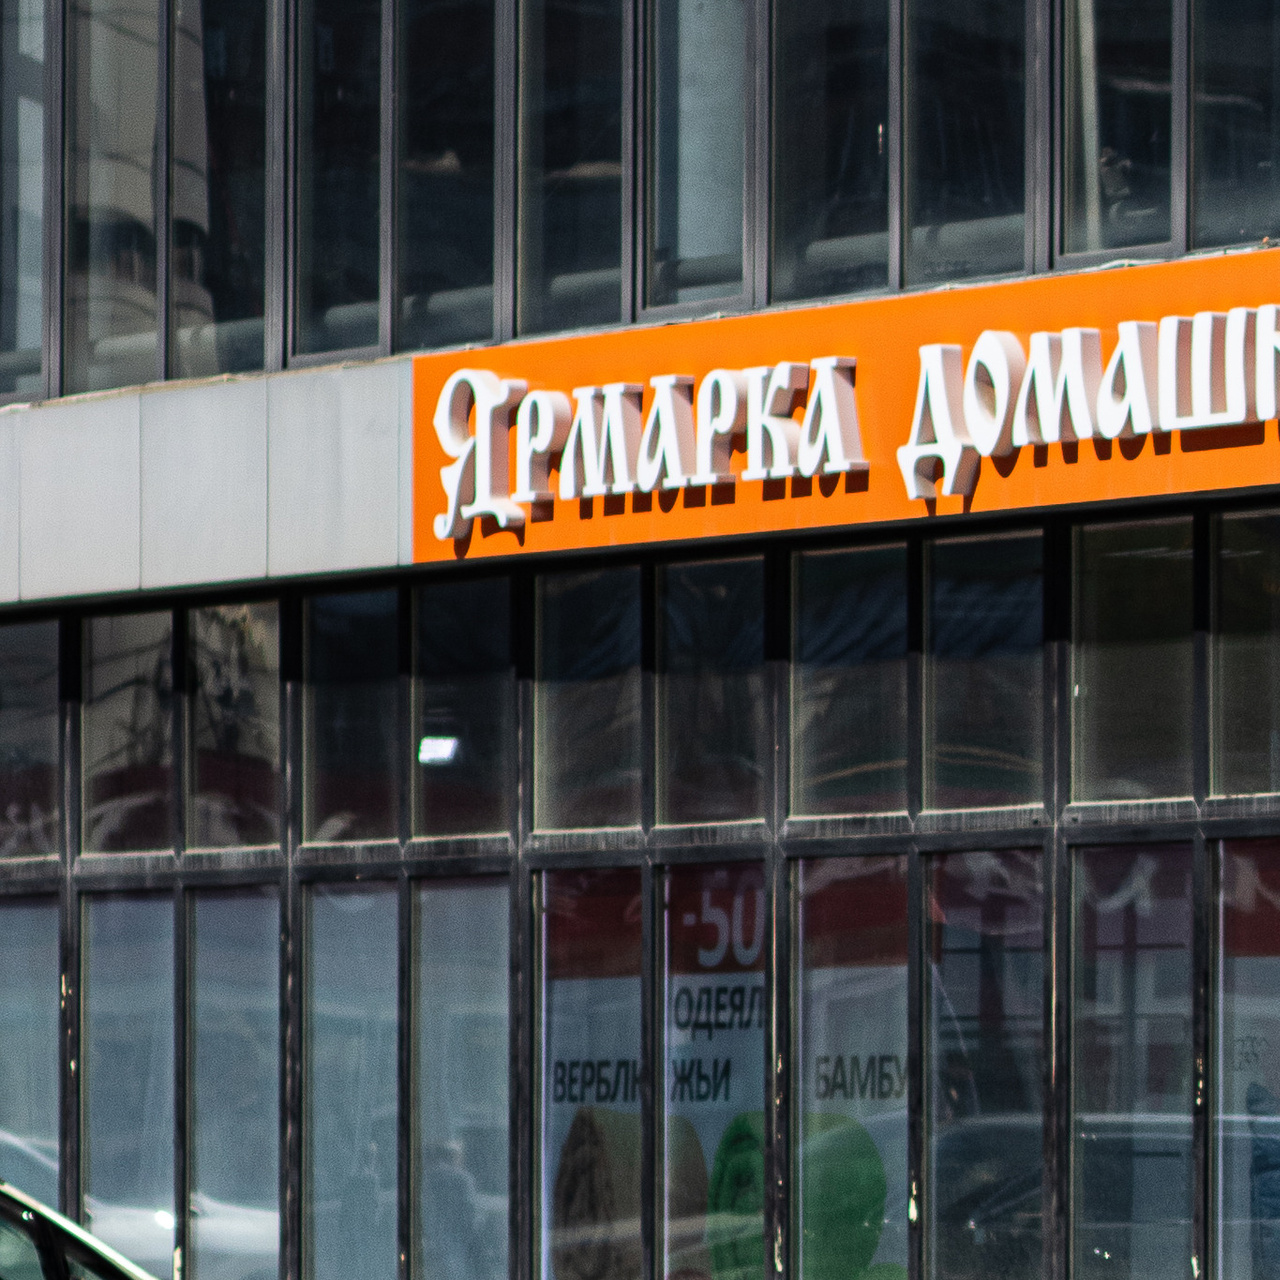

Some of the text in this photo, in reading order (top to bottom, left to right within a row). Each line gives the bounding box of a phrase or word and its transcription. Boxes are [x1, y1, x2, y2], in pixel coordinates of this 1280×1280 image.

[682, 866, 766, 968] -50
[674, 985, 765, 1041] ОДЕЯЛ
[815, 1054, 908, 1101] БАМБУ
